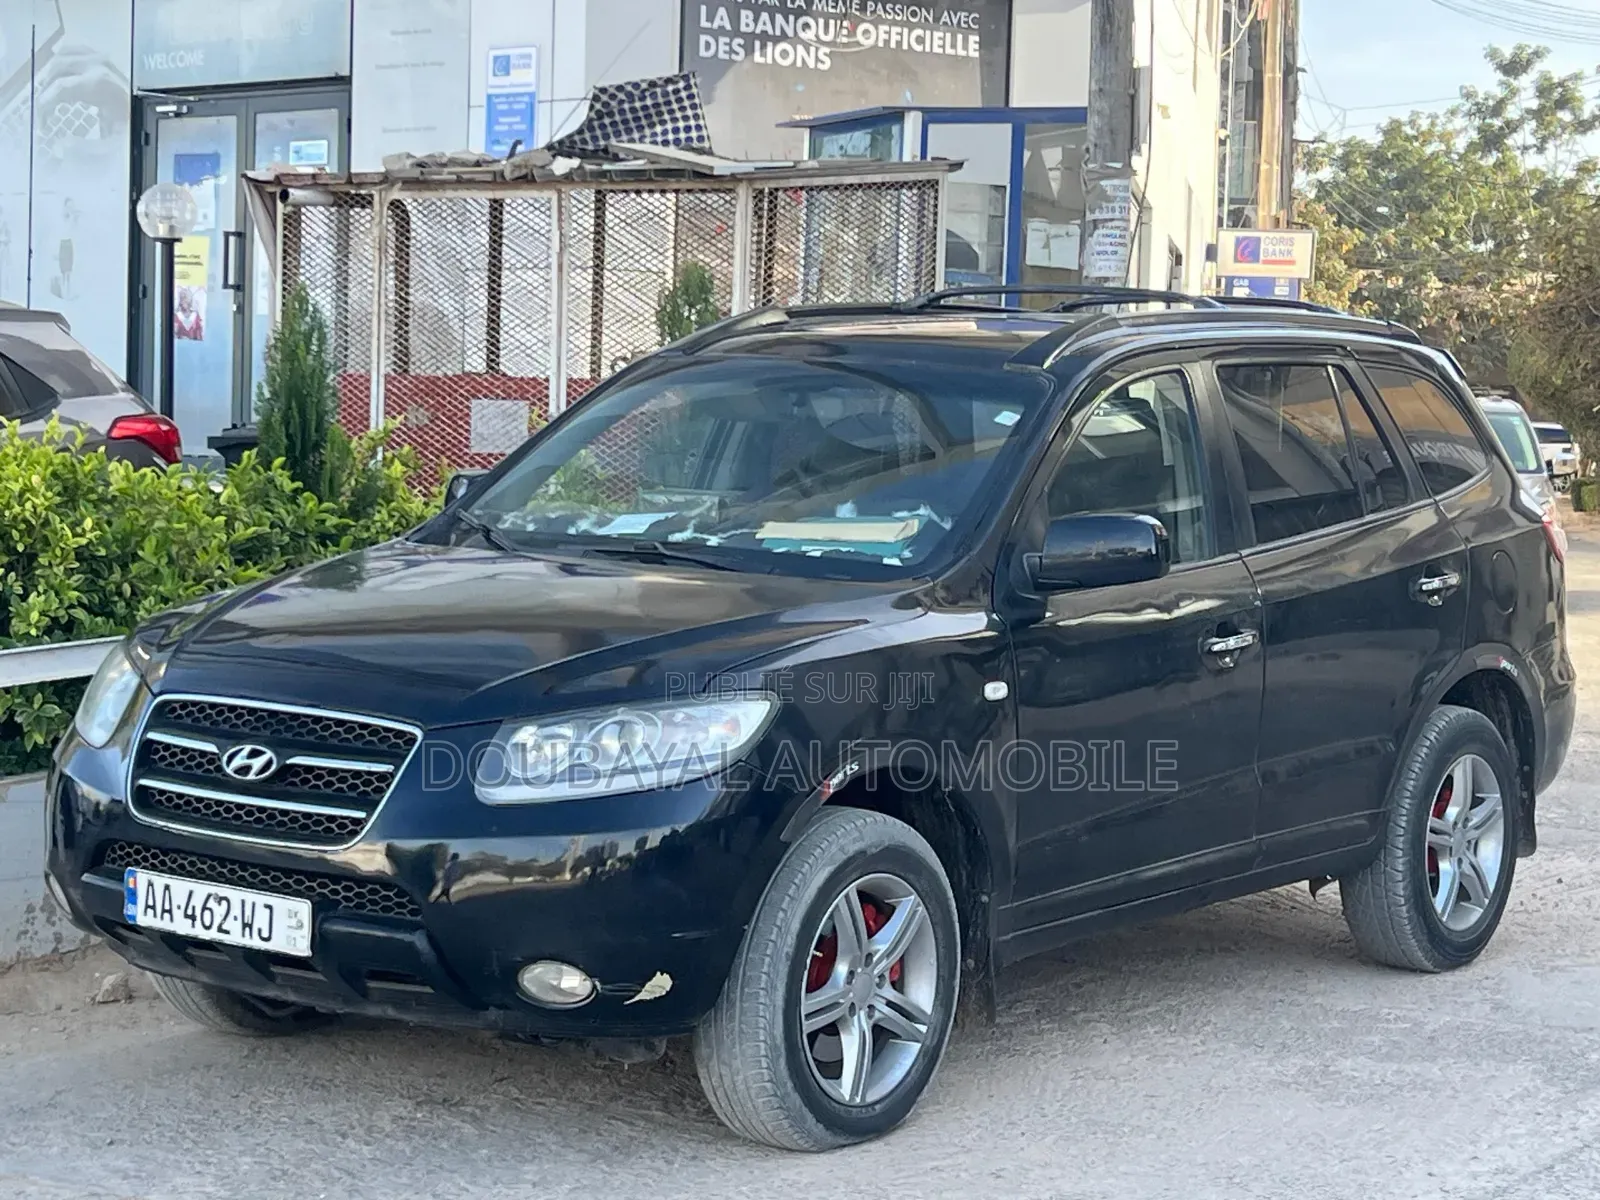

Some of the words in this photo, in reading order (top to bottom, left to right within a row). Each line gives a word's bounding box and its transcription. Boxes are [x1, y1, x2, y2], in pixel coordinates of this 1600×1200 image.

[866, 1, 934, 24] PASSION
[939, 9, 980, 29] AVEC
[700, 4, 732, 31] LA
[739, 8, 850, 44] BANQUE
[856, 22, 980, 58] OFFICIELLE
[143, 50, 205, 71] WELCOME
[699, 33, 746, 61] DES
[753, 40, 832, 71] LIONS
[1262, 247, 1293, 258] BANK
[1263, 236, 1295, 247] CORIS
